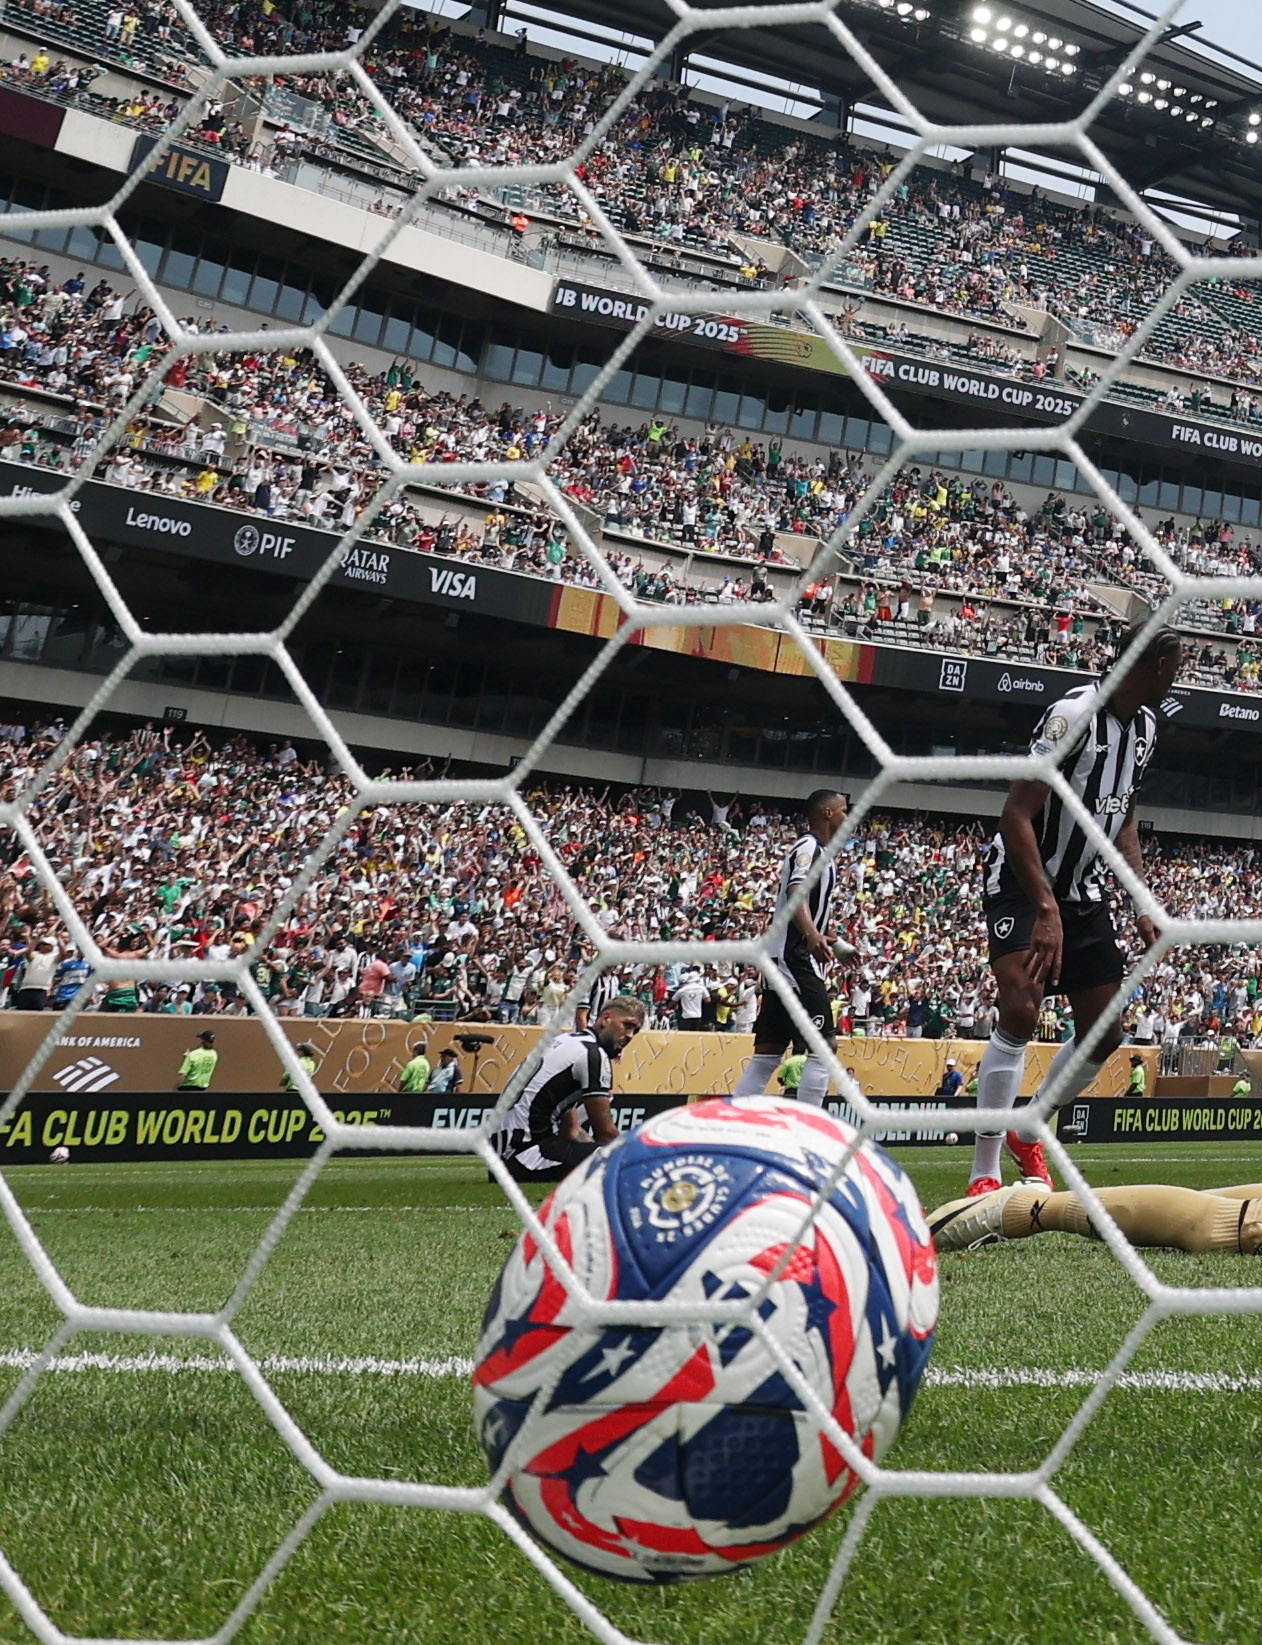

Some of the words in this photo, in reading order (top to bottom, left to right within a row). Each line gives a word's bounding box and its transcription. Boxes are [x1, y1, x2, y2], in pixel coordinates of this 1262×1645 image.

[149, 149, 211, 191] FIFA
[581, 293, 650, 323] WORLD
[655, 312, 691, 331] CUP
[861, 355, 895, 378] FIFA
[899, 365, 940, 386] CLUB
[943, 374, 1000, 399] WORLD
[1002, 388, 1032, 406] CUP
[1172, 425, 1201, 445] FIFA
[1203, 432, 1238, 451] CLUB
[125, 507, 192, 537] Lenovo
[259, 533, 296, 559] PIF
[345, 566, 387, 584] AIRWAYS
[428, 566, 477, 600] VISA
[1013, 679, 1044, 693] airbnb
[167, 708, 184, 719] 119
[1219, 703, 1260, 721] Betano
[56, 1036, 77, 1047] ANK
[77, 1036, 93, 1047] OF
[92, 1036, 141, 1048] AMERICA
[42, 1109, 130, 1147] CLUB
[137, 1109, 243, 1145] WORLD
[248, 1109, 306, 1144] CUP
[432, 1107, 494, 1130] EVE
[1114, 1109, 1142, 1132] FIFA
[1145, 1109, 1179, 1132] CLUB
[1182, 1108, 1226, 1131] WORLD
[1228, 1108, 1251, 1130] CUP
